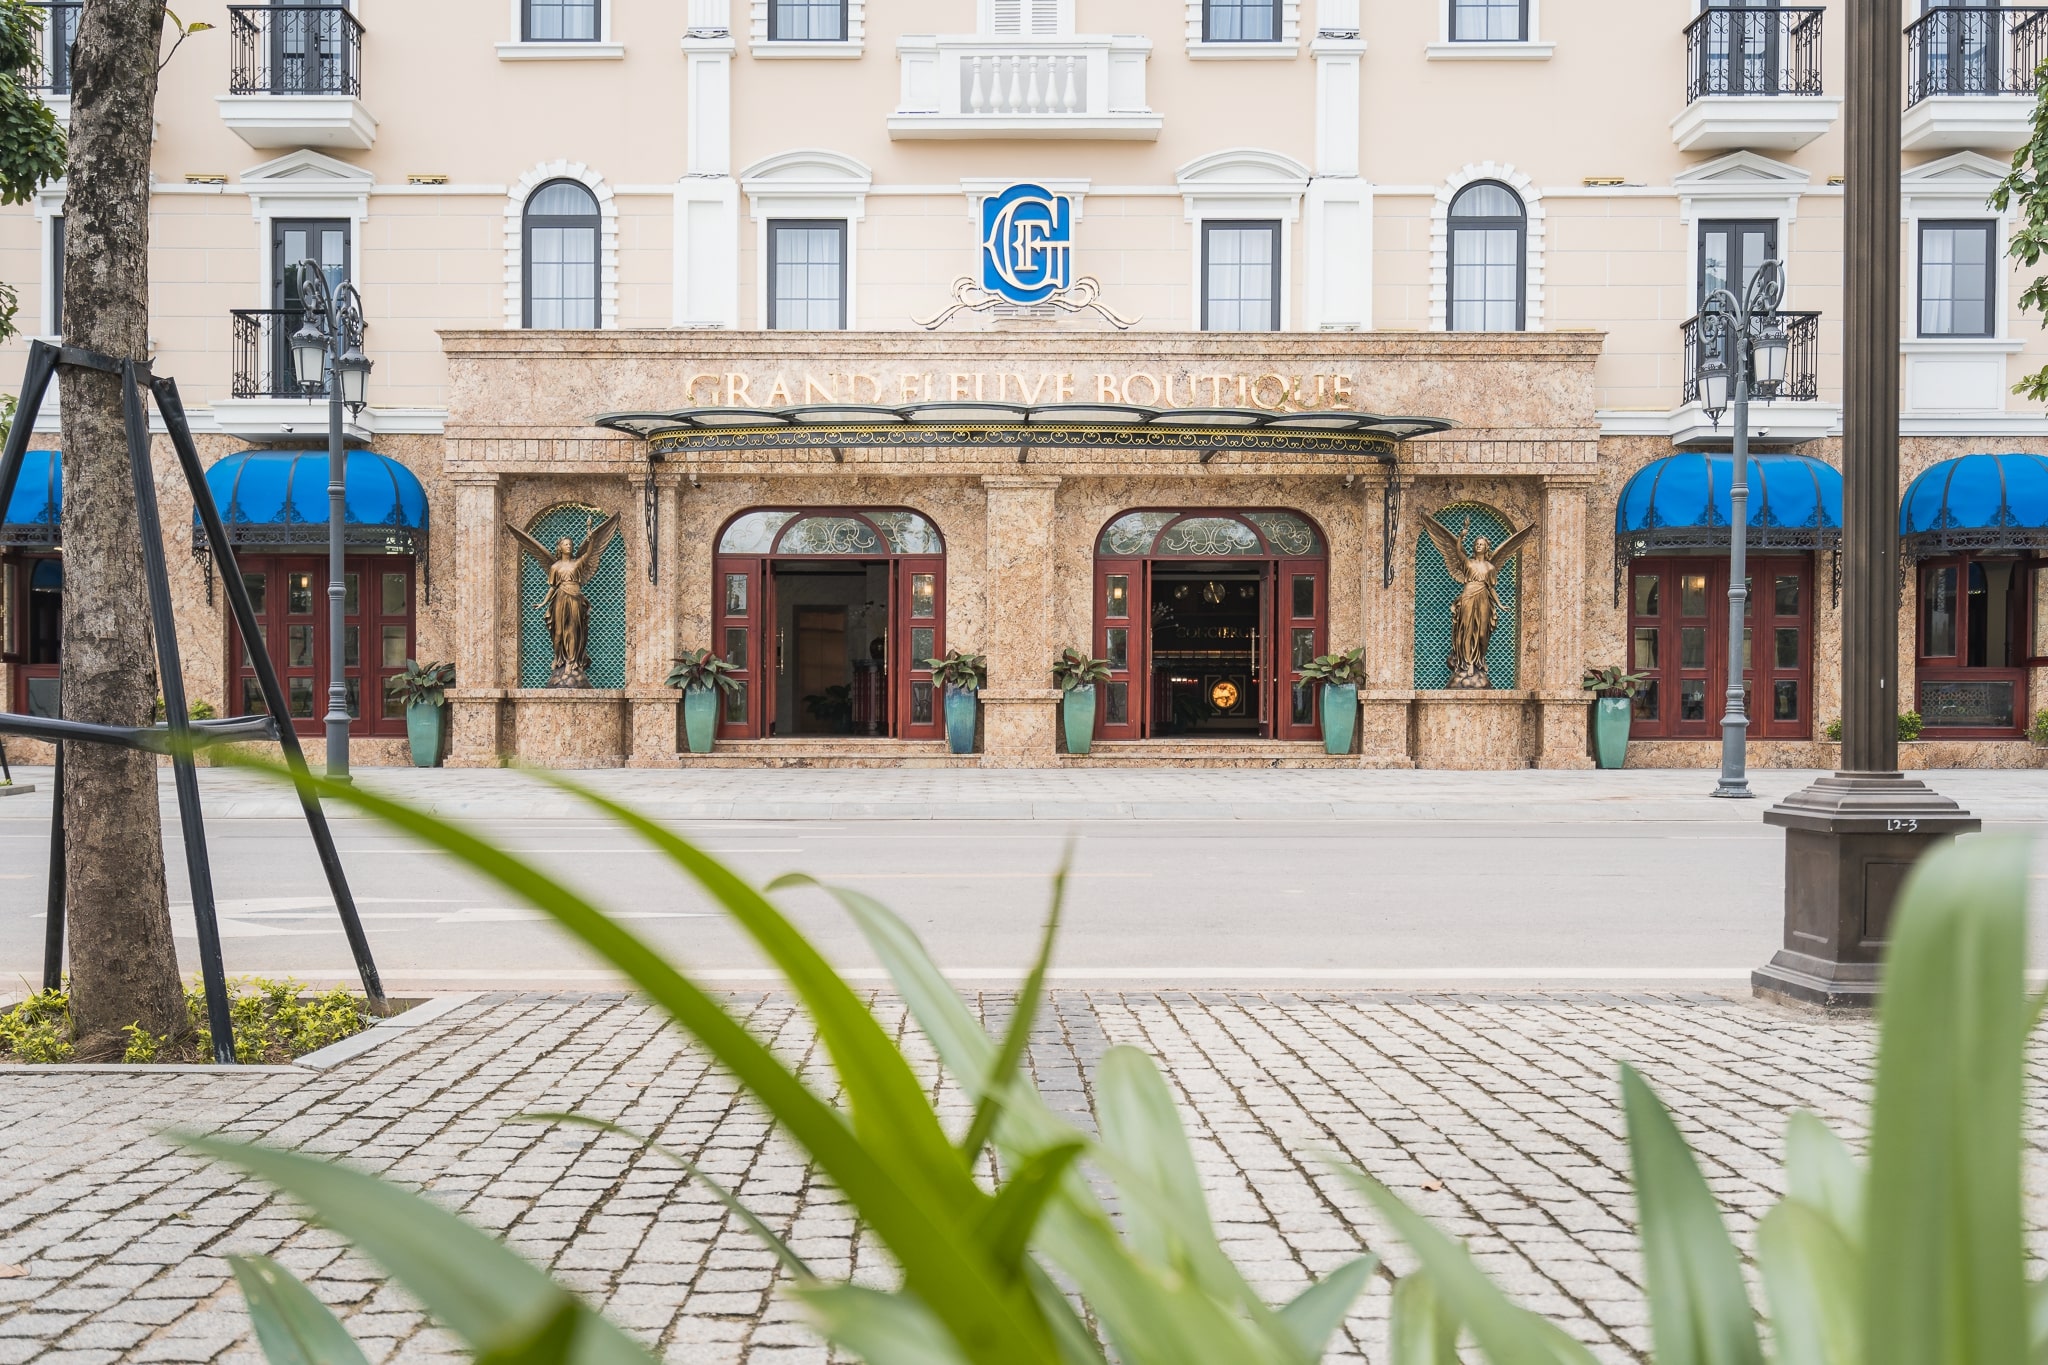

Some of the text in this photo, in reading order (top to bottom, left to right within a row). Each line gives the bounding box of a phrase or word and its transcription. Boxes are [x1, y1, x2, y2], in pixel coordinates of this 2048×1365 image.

[685, 372, 1353, 413] GRAND FLEUVE BOUTIQUE
[1887, 819, 1918, 833] L2-3
